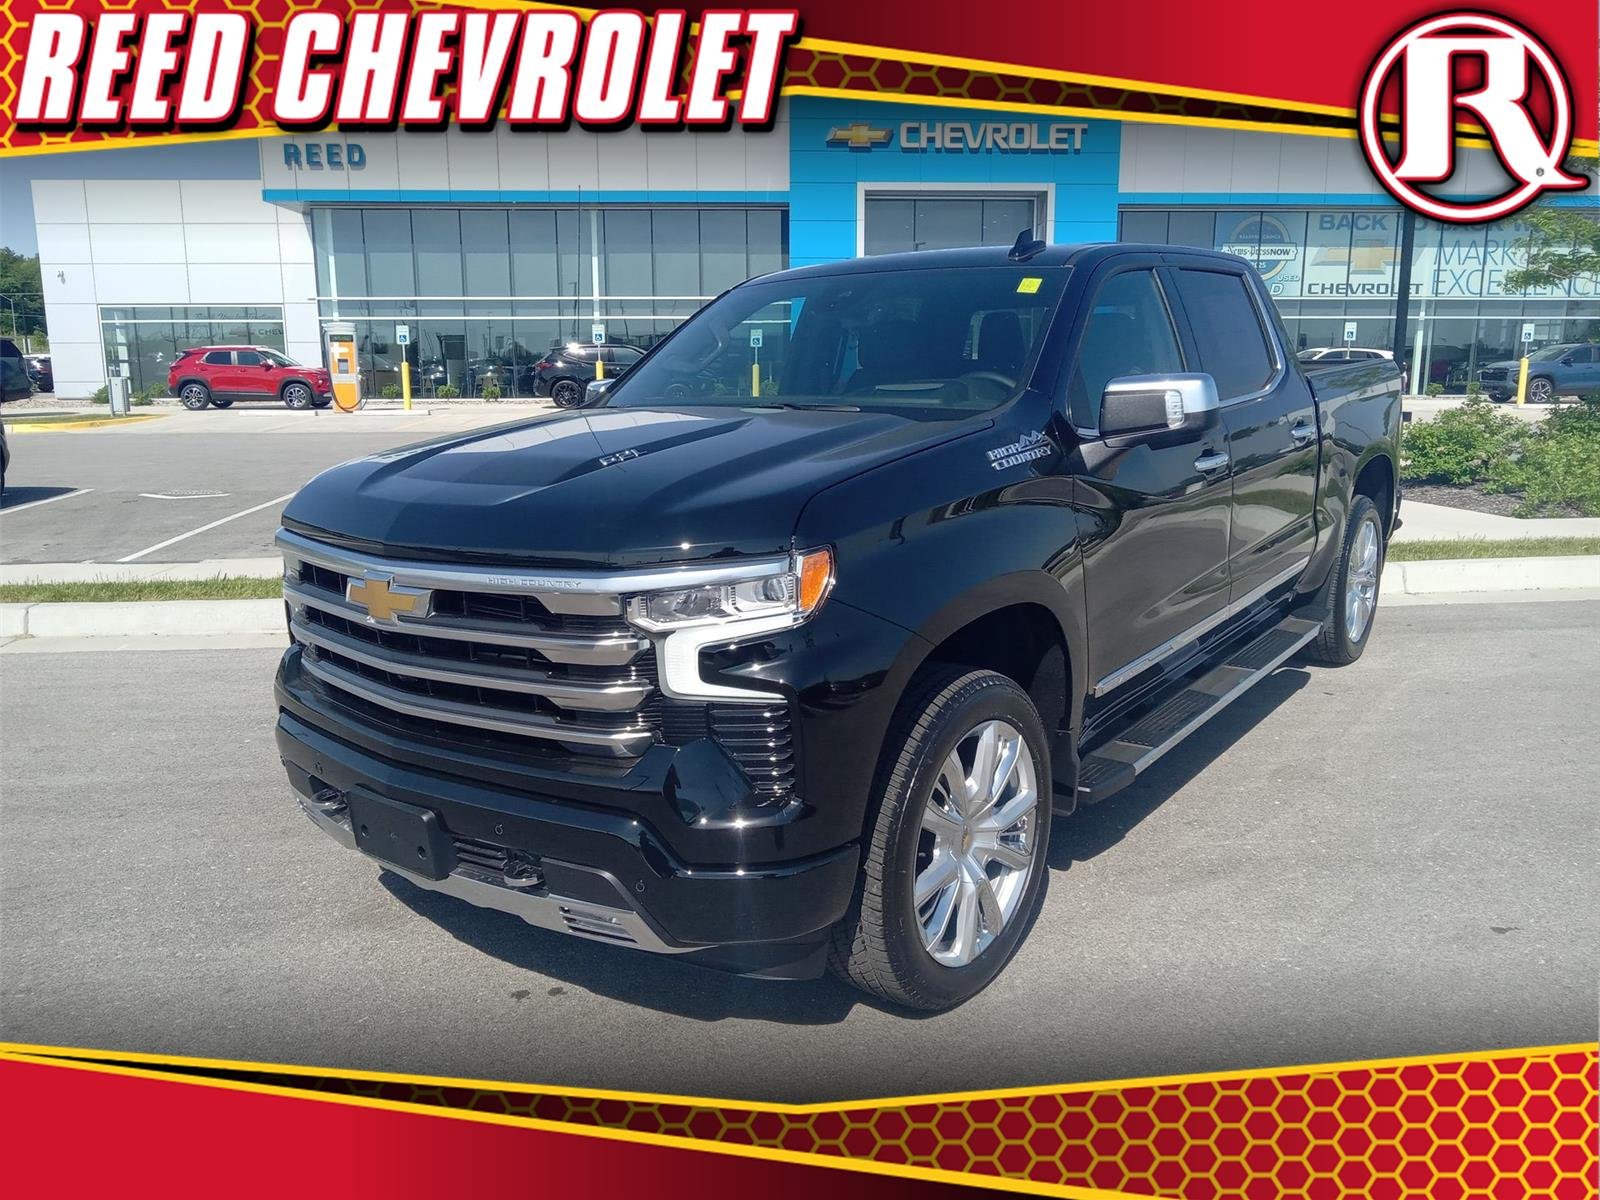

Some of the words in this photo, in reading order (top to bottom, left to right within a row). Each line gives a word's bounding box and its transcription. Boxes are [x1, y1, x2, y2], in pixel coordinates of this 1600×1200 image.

[901, 122, 1088, 150] CHEVROLET
[283, 143, 366, 168] REED
[1319, 214, 1388, 231] BACK
[1433, 240, 1516, 265] MARK
[1308, 283, 1423, 295] CHEVROLT
[1432, 269, 1600, 295] EXCENC
[987, 442, 1021, 460] HIGH
[991, 445, 1051, 470] COUNTRY
[487, 576, 516, 585] HIGH
[519, 579, 581, 588] COUNTRY
